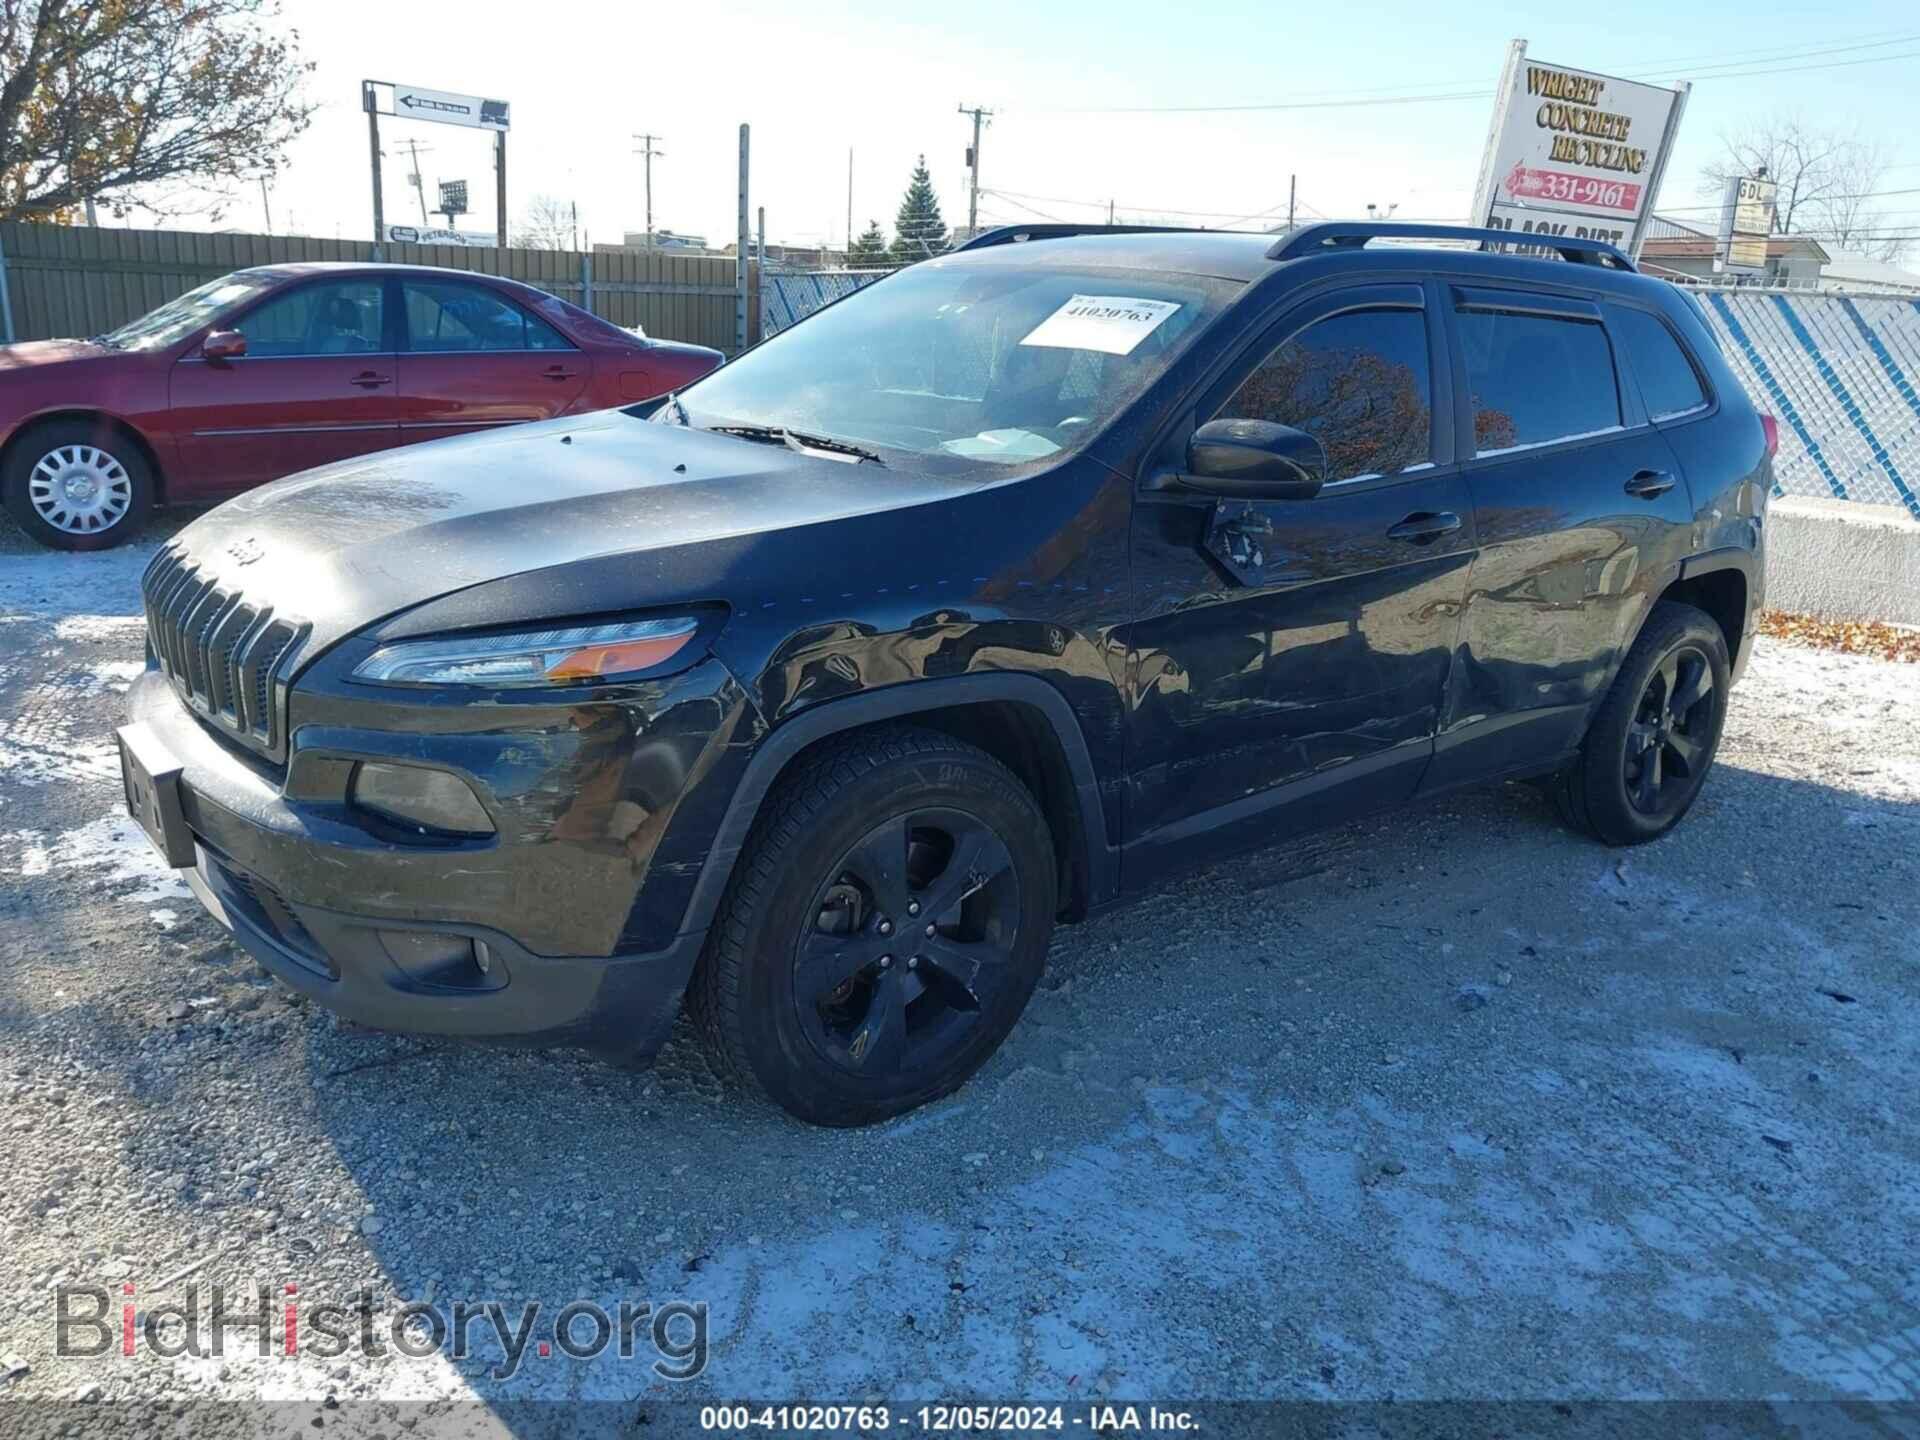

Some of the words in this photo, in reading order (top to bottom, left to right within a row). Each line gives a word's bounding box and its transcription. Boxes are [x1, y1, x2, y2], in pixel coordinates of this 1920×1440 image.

[1527, 67, 1605, 106] WRIGHT
[1536, 101, 1632, 142] CONCRETE
[1548, 135, 1647, 174] RECYCLING
[1541, 174, 1626, 207] 331-9161
[1740, 182, 1762, 201] GDL
[1066, 306, 1152, 322] 41020763
